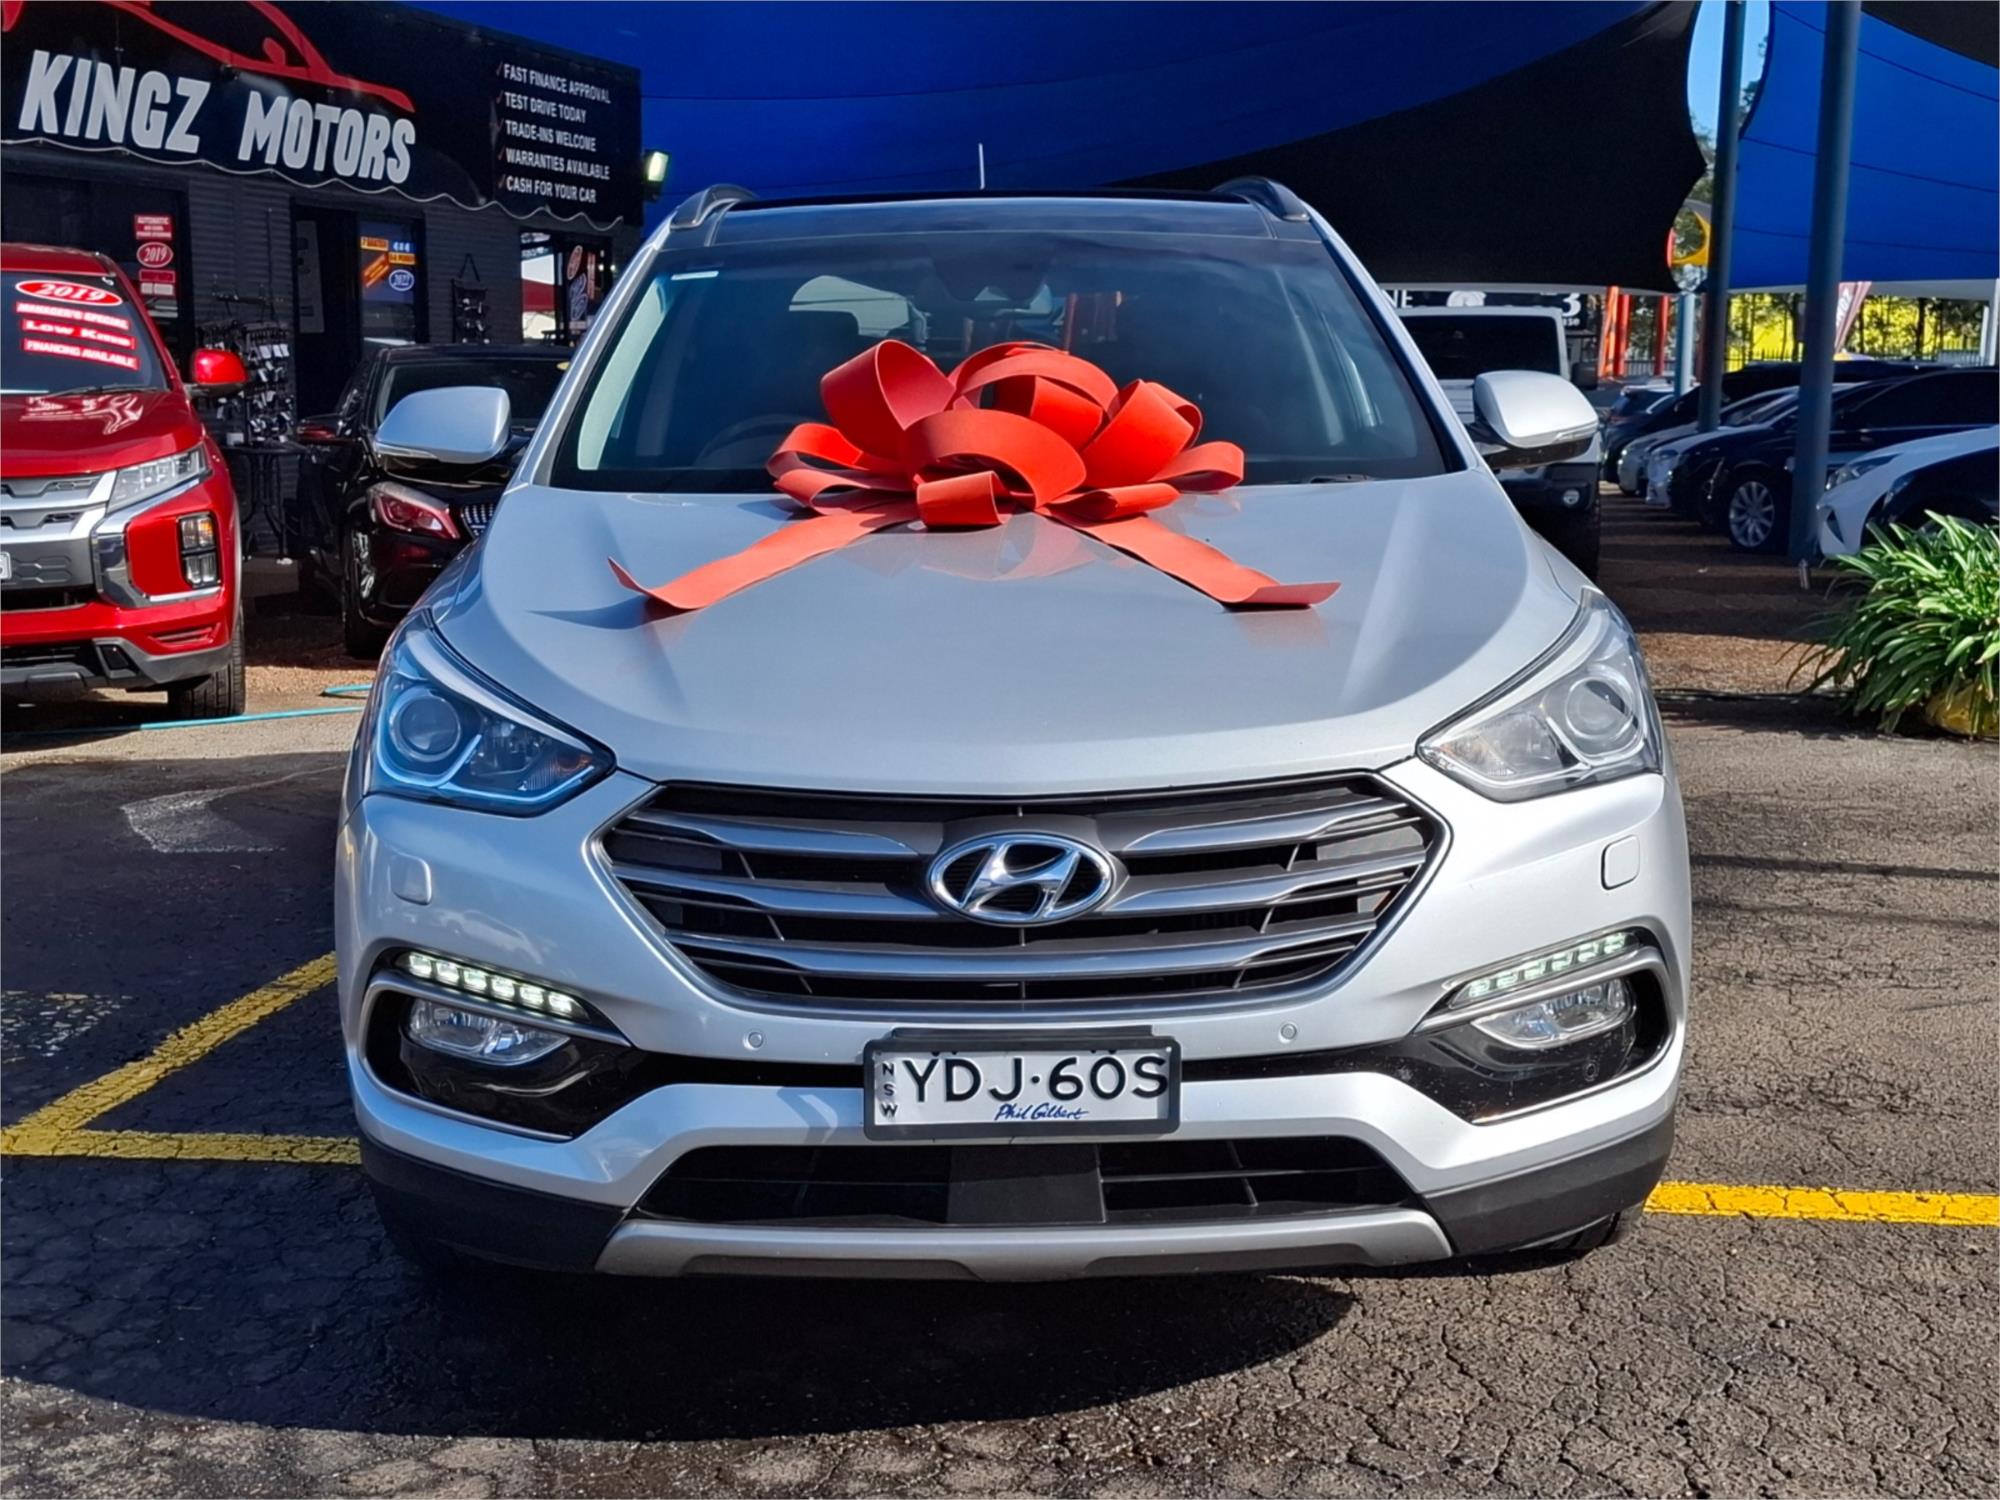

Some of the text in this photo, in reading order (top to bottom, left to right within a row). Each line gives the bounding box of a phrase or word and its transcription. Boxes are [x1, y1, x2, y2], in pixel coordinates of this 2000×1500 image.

[503, 63, 611, 104] FAST FINANCE APPROVAL
[18, 49, 416, 184] KINGZ MOTORS
[504, 91, 587, 124] TEST DRIVE TODAY
[505, 119, 597, 152] TRADE-INS WELCOME
[505, 147, 610, 181] WARRANTIES AVAILABLE
[506, 175, 597, 204] CASH FOR YOUR CAR
[143, 246, 168, 262] 2019
[35, 282, 108, 301] 2019
[26, 319, 75, 336] Low
[27, 339, 136, 368] FINANCING AVAILABLE
[994, 1101, 1089, 1121] Phil Gilbert
